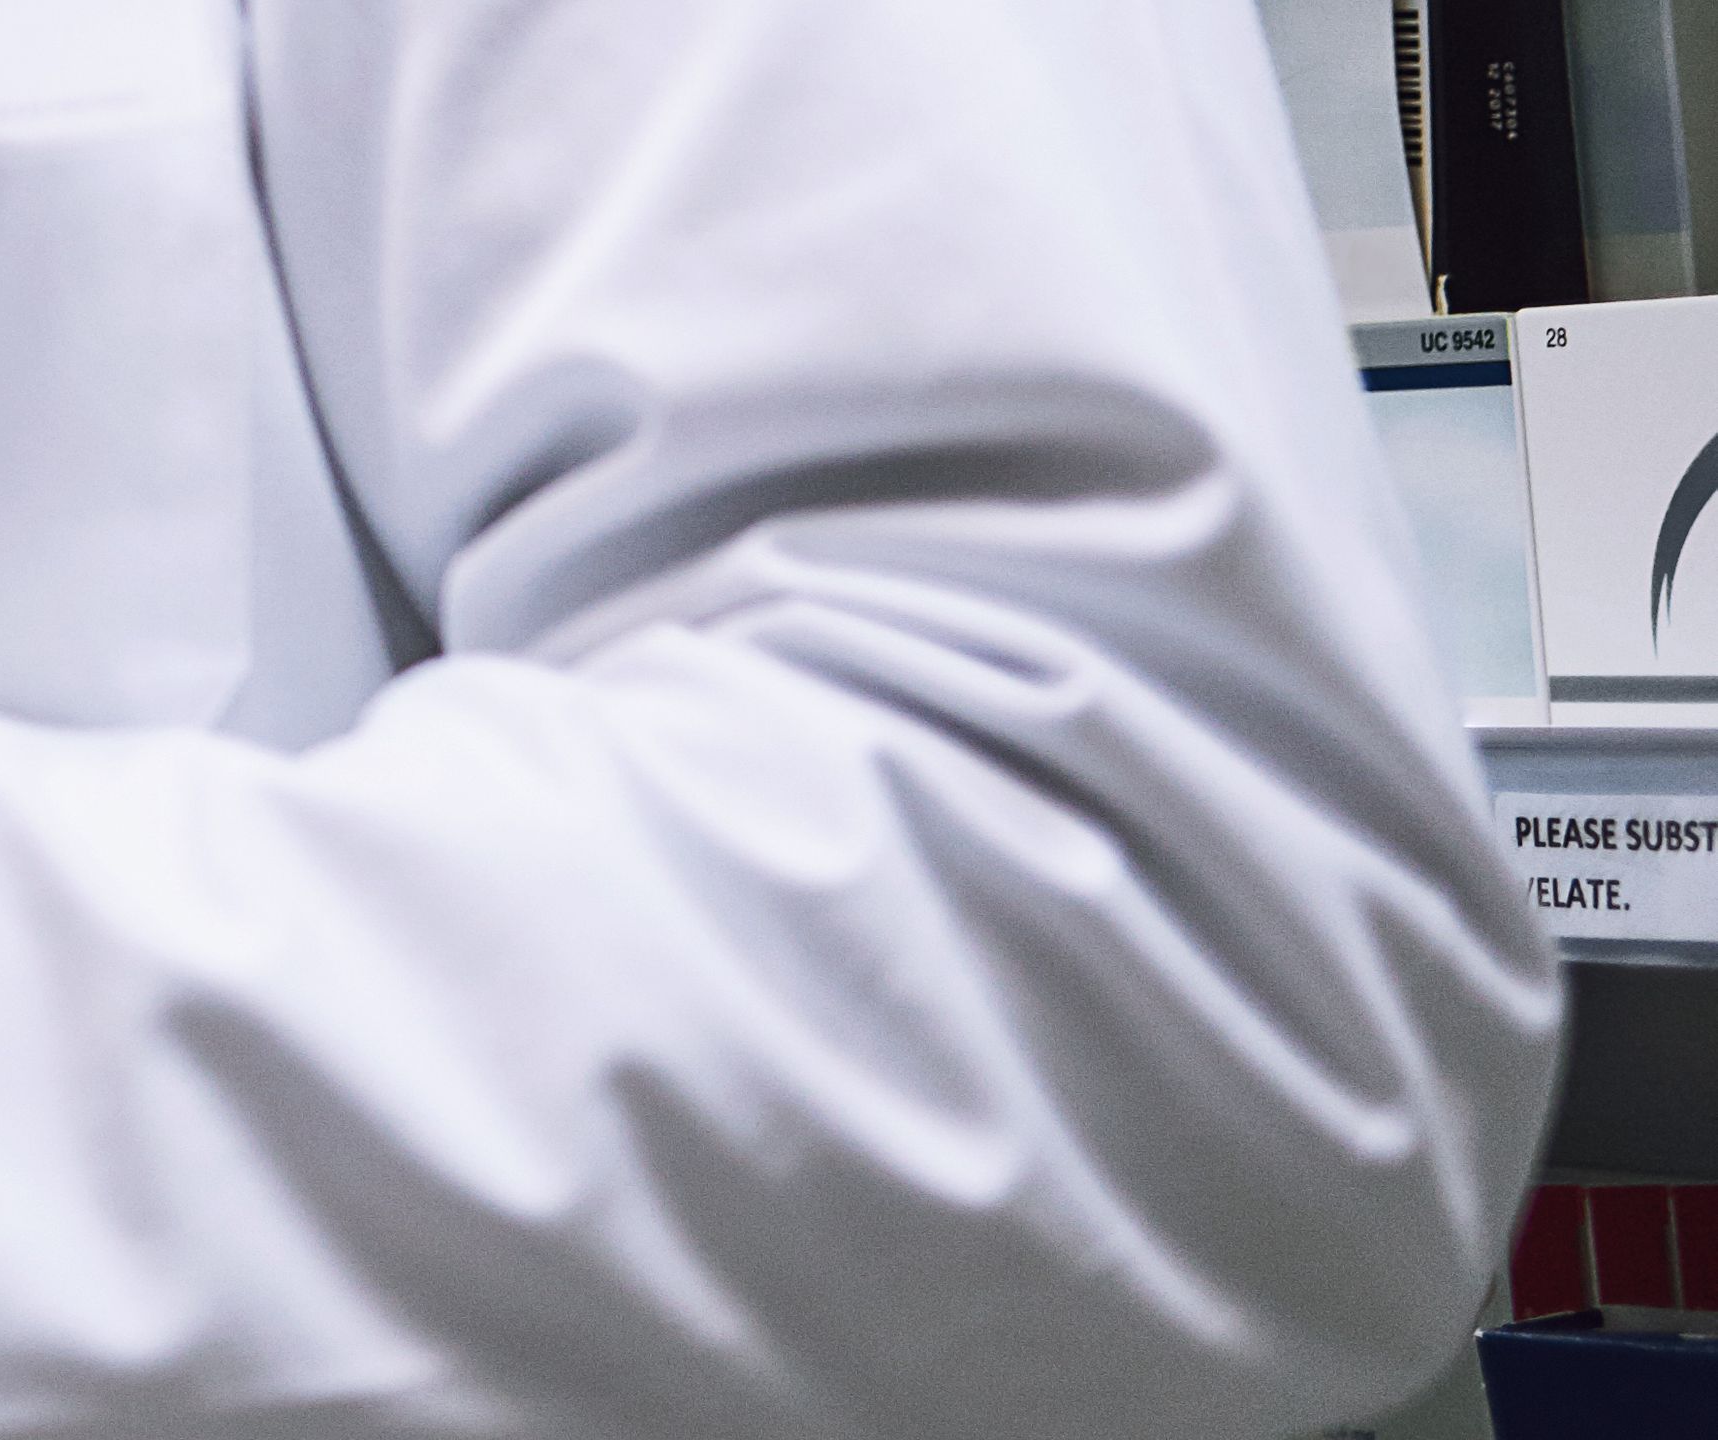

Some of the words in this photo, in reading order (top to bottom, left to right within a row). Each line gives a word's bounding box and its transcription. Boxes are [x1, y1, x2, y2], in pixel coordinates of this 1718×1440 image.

[1421, 332, 1447, 352] UC
[1452, 329, 1495, 352] 9542
[1546, 327, 1567, 348] 28
[1516, 816, 1617, 850] PLEASE
[1626, 818, 1718, 852] SUBST
